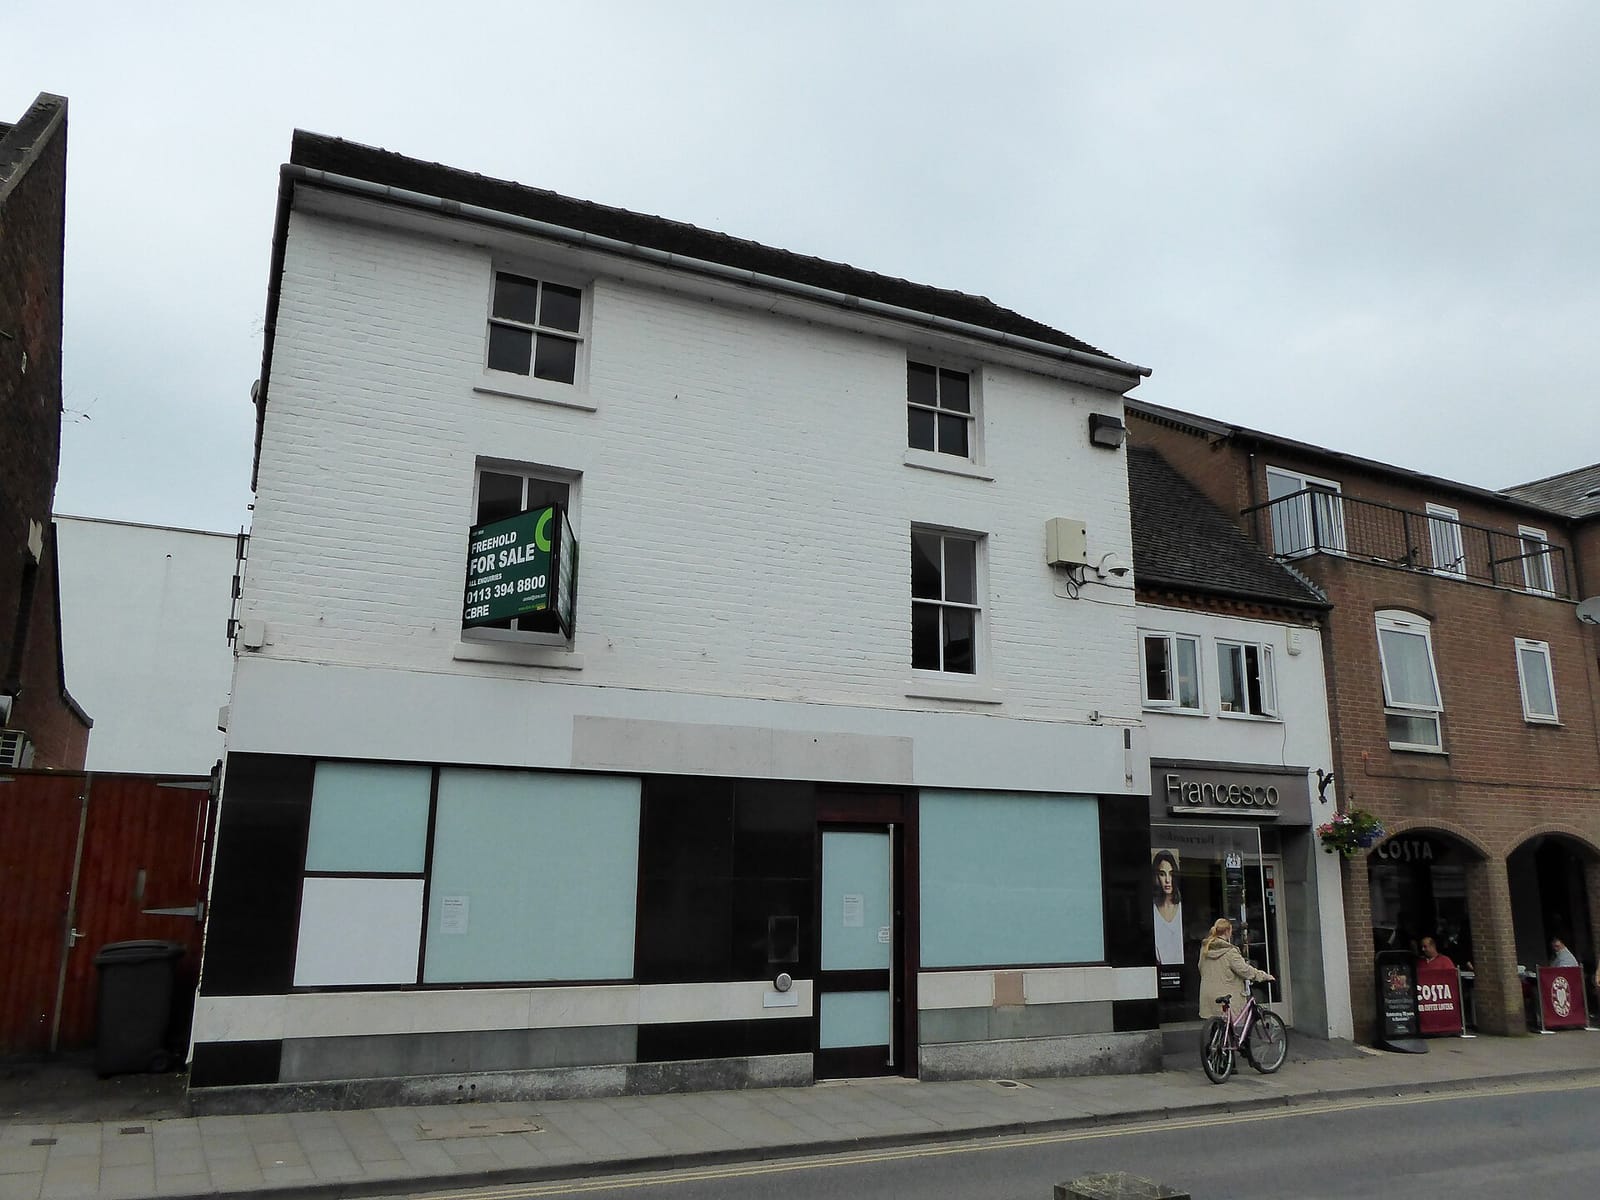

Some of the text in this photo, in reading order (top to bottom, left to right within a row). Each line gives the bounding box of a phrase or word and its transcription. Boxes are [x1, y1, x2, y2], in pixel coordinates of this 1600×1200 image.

[472, 531, 516, 553] FREEHOLD
[470, 543, 535, 575] FOR SALE
[467, 587, 491, 604] 0113
[494, 581, 514, 598] 394
[517, 574, 546, 592] 8800
[465, 604, 489, 619] CBRE
[1166, 773, 1279, 806] Francesco
